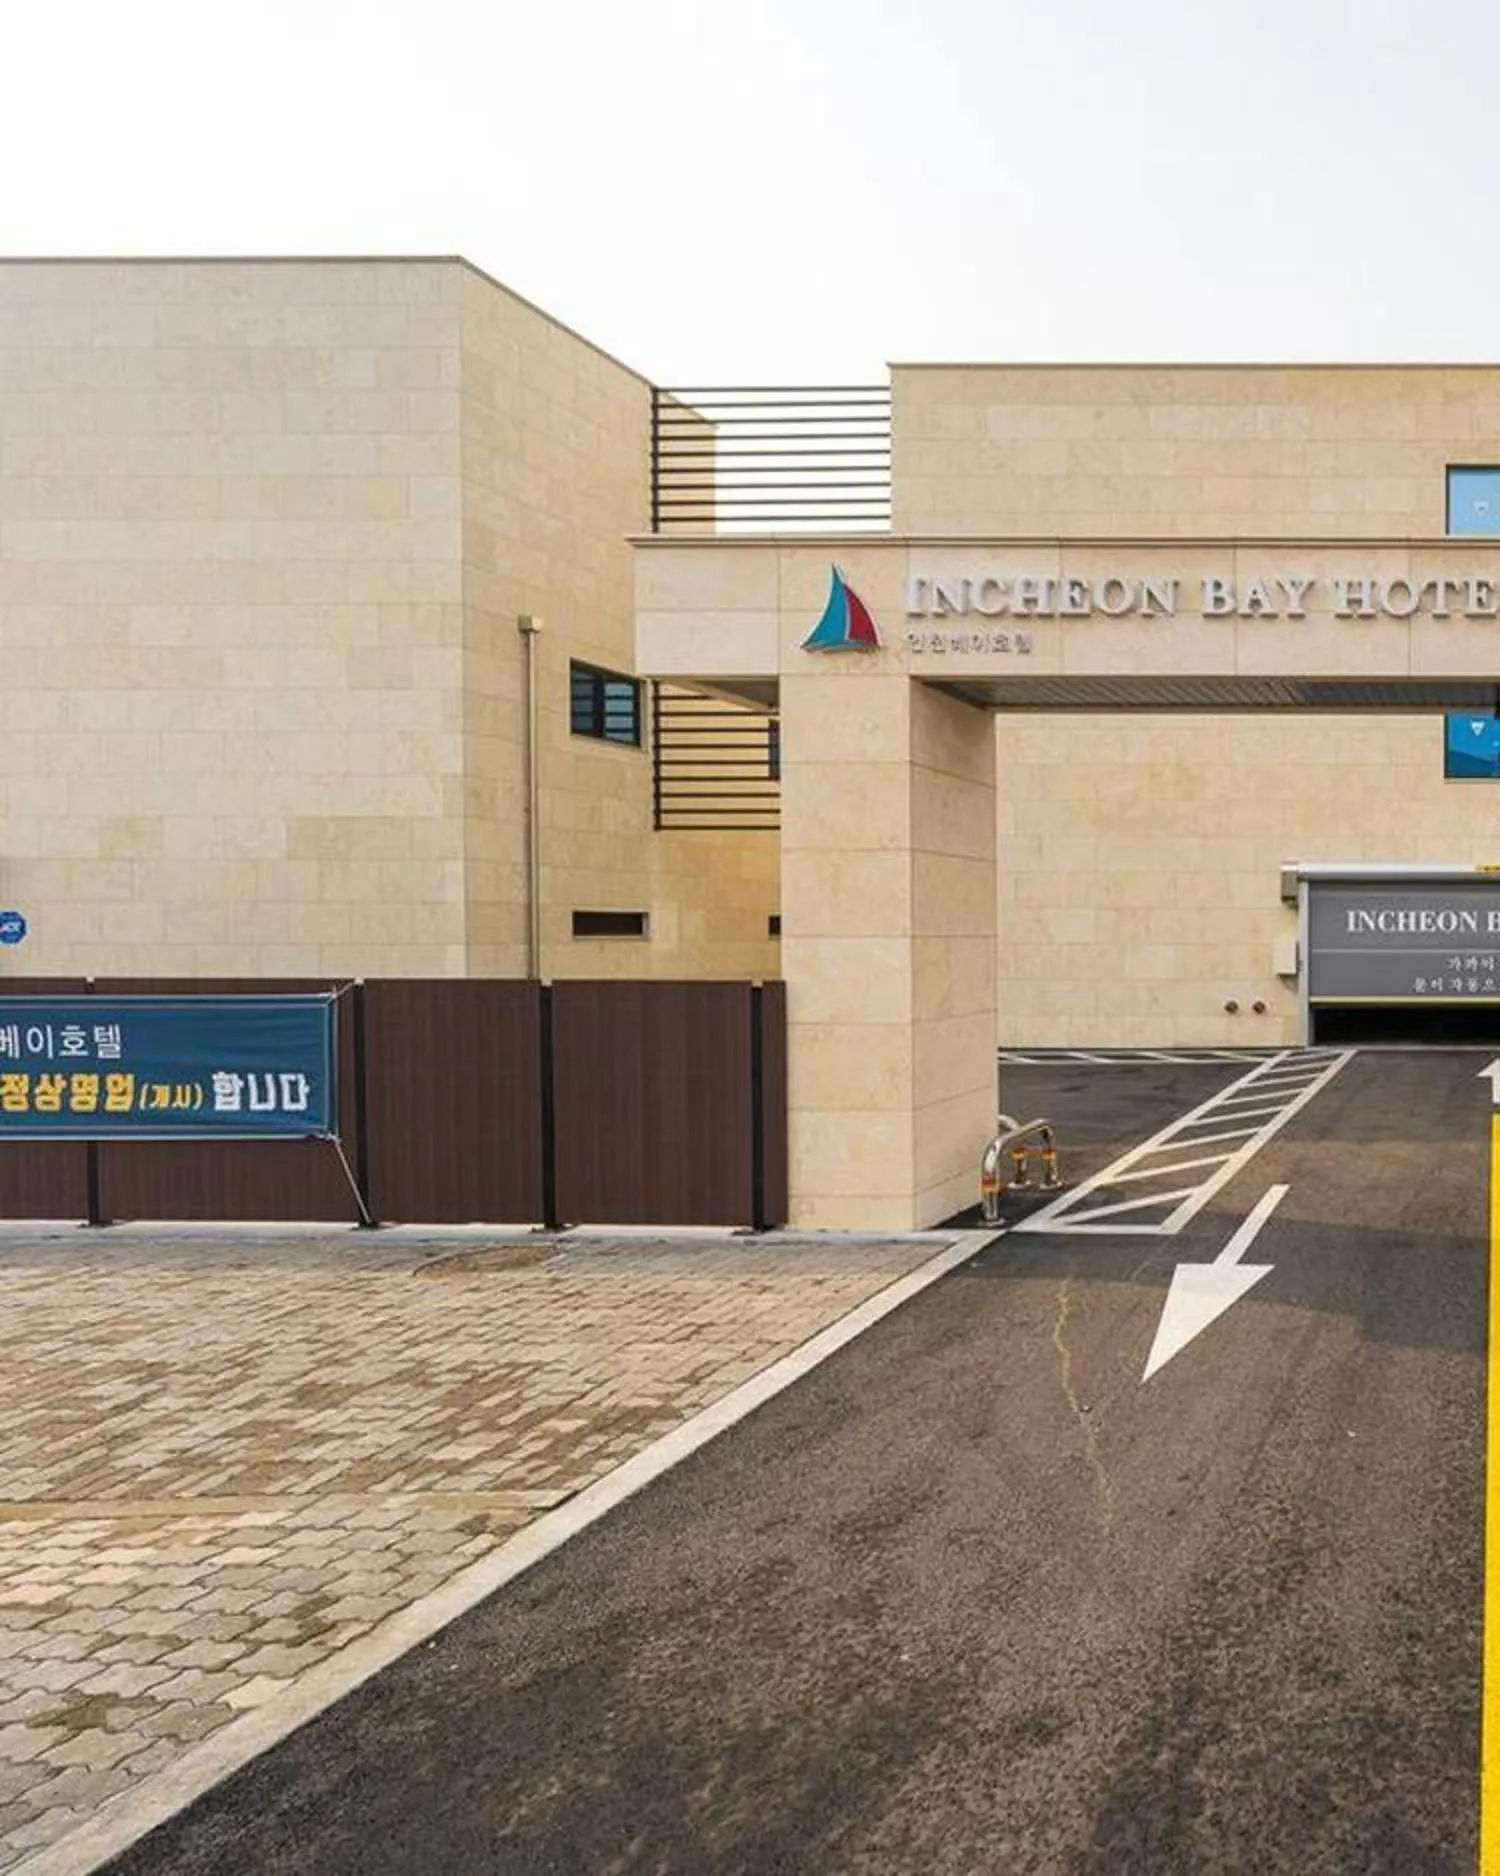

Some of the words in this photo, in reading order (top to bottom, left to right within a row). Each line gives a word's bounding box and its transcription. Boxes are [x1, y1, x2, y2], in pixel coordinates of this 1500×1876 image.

[905, 577, 1180, 618] INCHEON
[1201, 577, 1315, 618] BAY
[1347, 910, 1478, 933] INCHEON
[212, 1071, 311, 1111] 합니다
